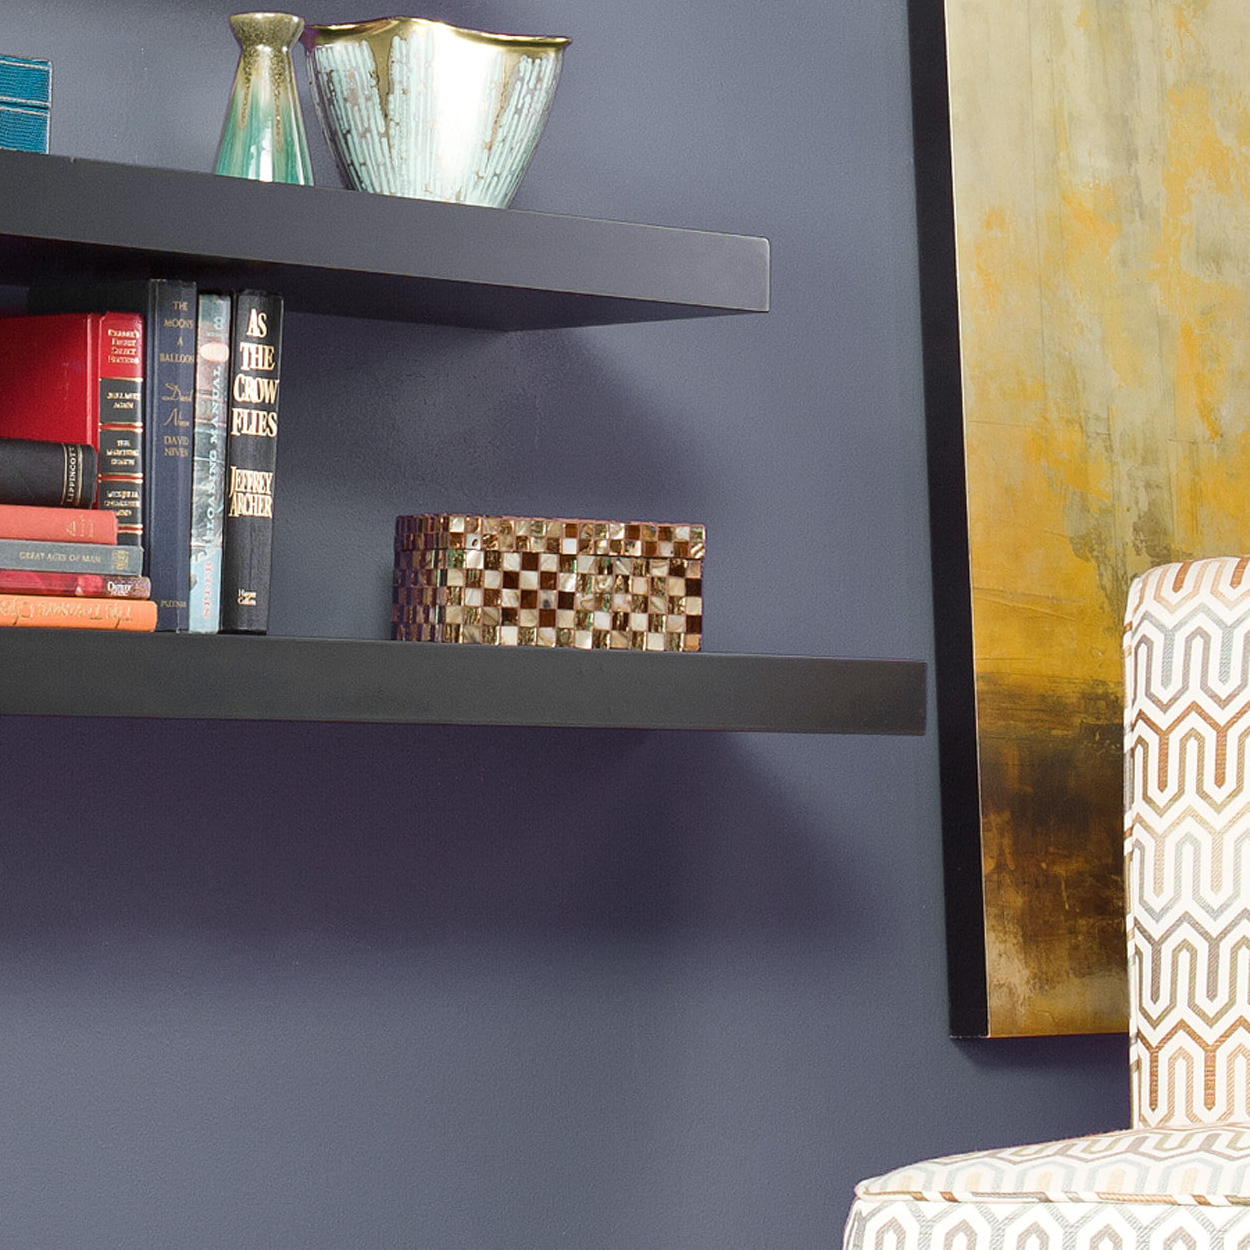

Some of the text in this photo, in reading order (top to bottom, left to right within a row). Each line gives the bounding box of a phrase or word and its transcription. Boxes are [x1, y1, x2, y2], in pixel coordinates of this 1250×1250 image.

[174, 301, 188, 311] THE
[246, 308, 267, 338] AS
[240, 342, 276, 371] THE
[233, 373, 280, 404] CROW
[231, 408, 279, 438] FLIES
[66, 446, 78, 502] LIPPINCOTT
[229, 465, 273, 498] JEFFREY
[228, 493, 273, 518] ARCHER
[19, 551, 45, 561] GREAT
[46, 553, 67, 562] AGES
